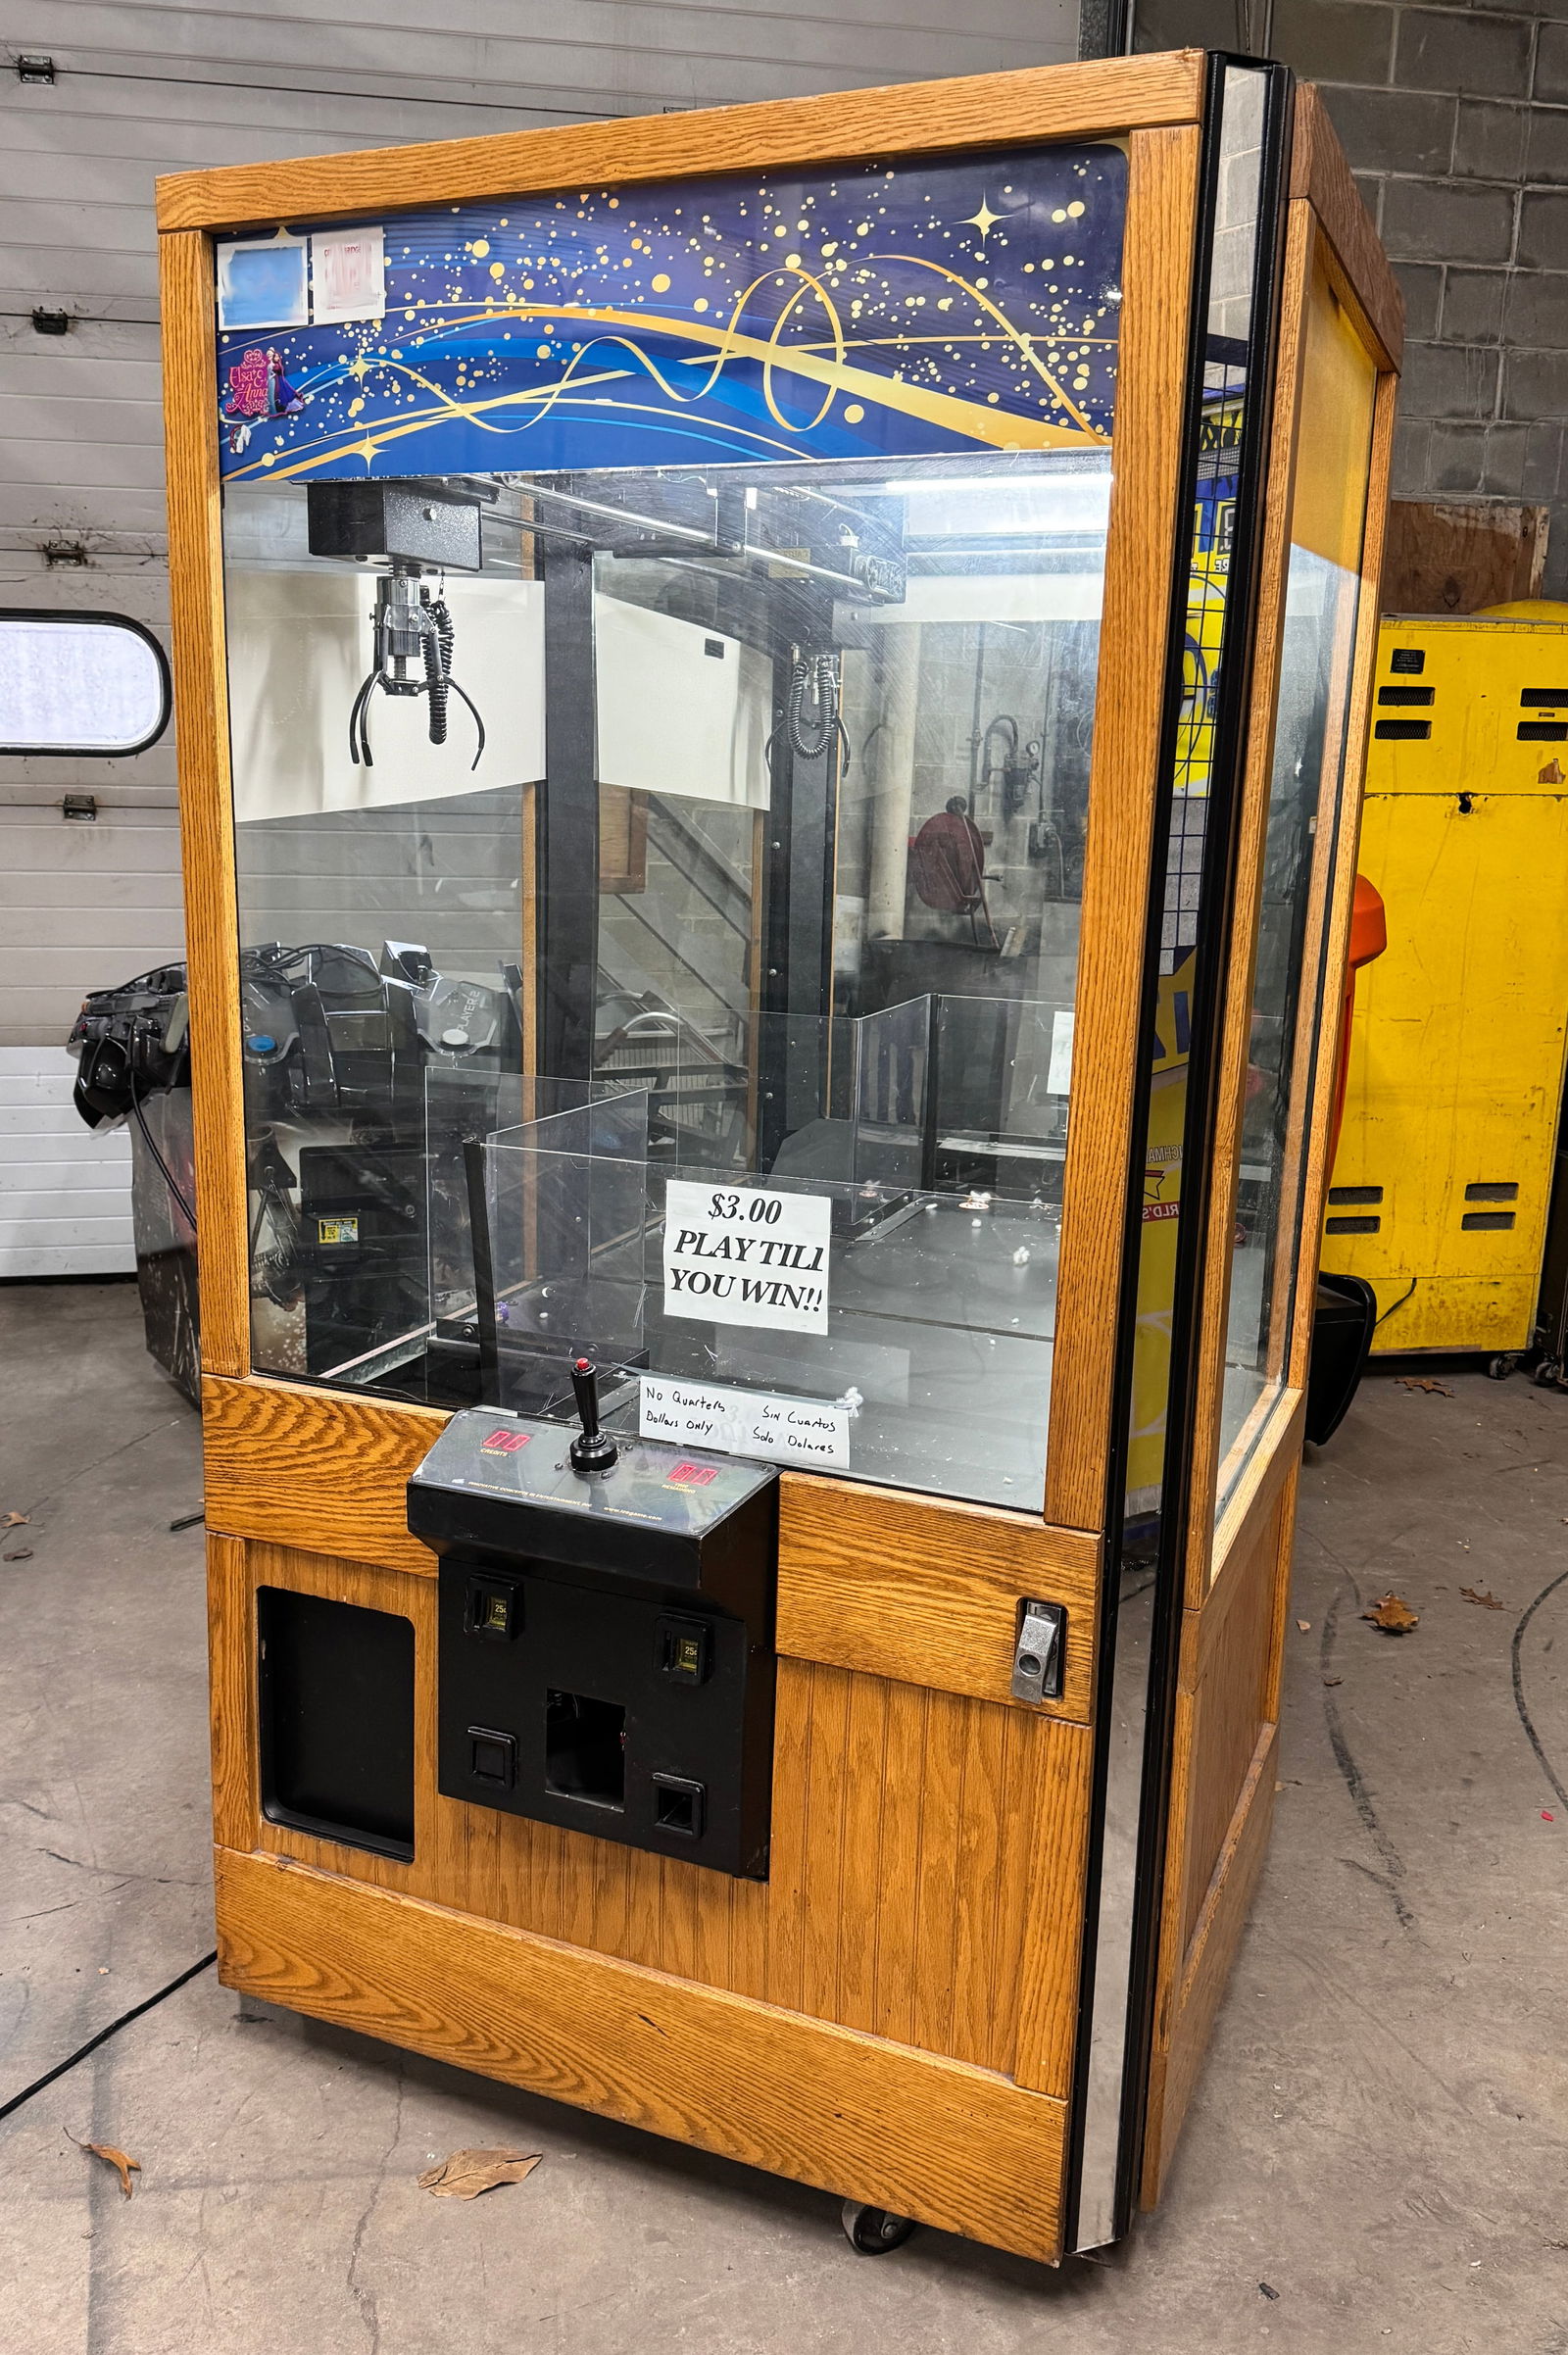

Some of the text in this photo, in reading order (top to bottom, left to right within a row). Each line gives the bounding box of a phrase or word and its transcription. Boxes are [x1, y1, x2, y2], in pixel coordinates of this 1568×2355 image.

[708, 1193, 782, 1225] $3.00
[673, 1229, 757, 1262] PLAY
[669, 1267, 823, 1312] YOU WIN!!
[646, 1386, 727, 1413] No Quarters
[646, 1409, 679, 1428] Dollars
[787, 1410, 836, 1432] Cuartos
[480, 1447, 509, 1457] CREDITS
[753, 1425, 835, 1454] Solo Dolares
